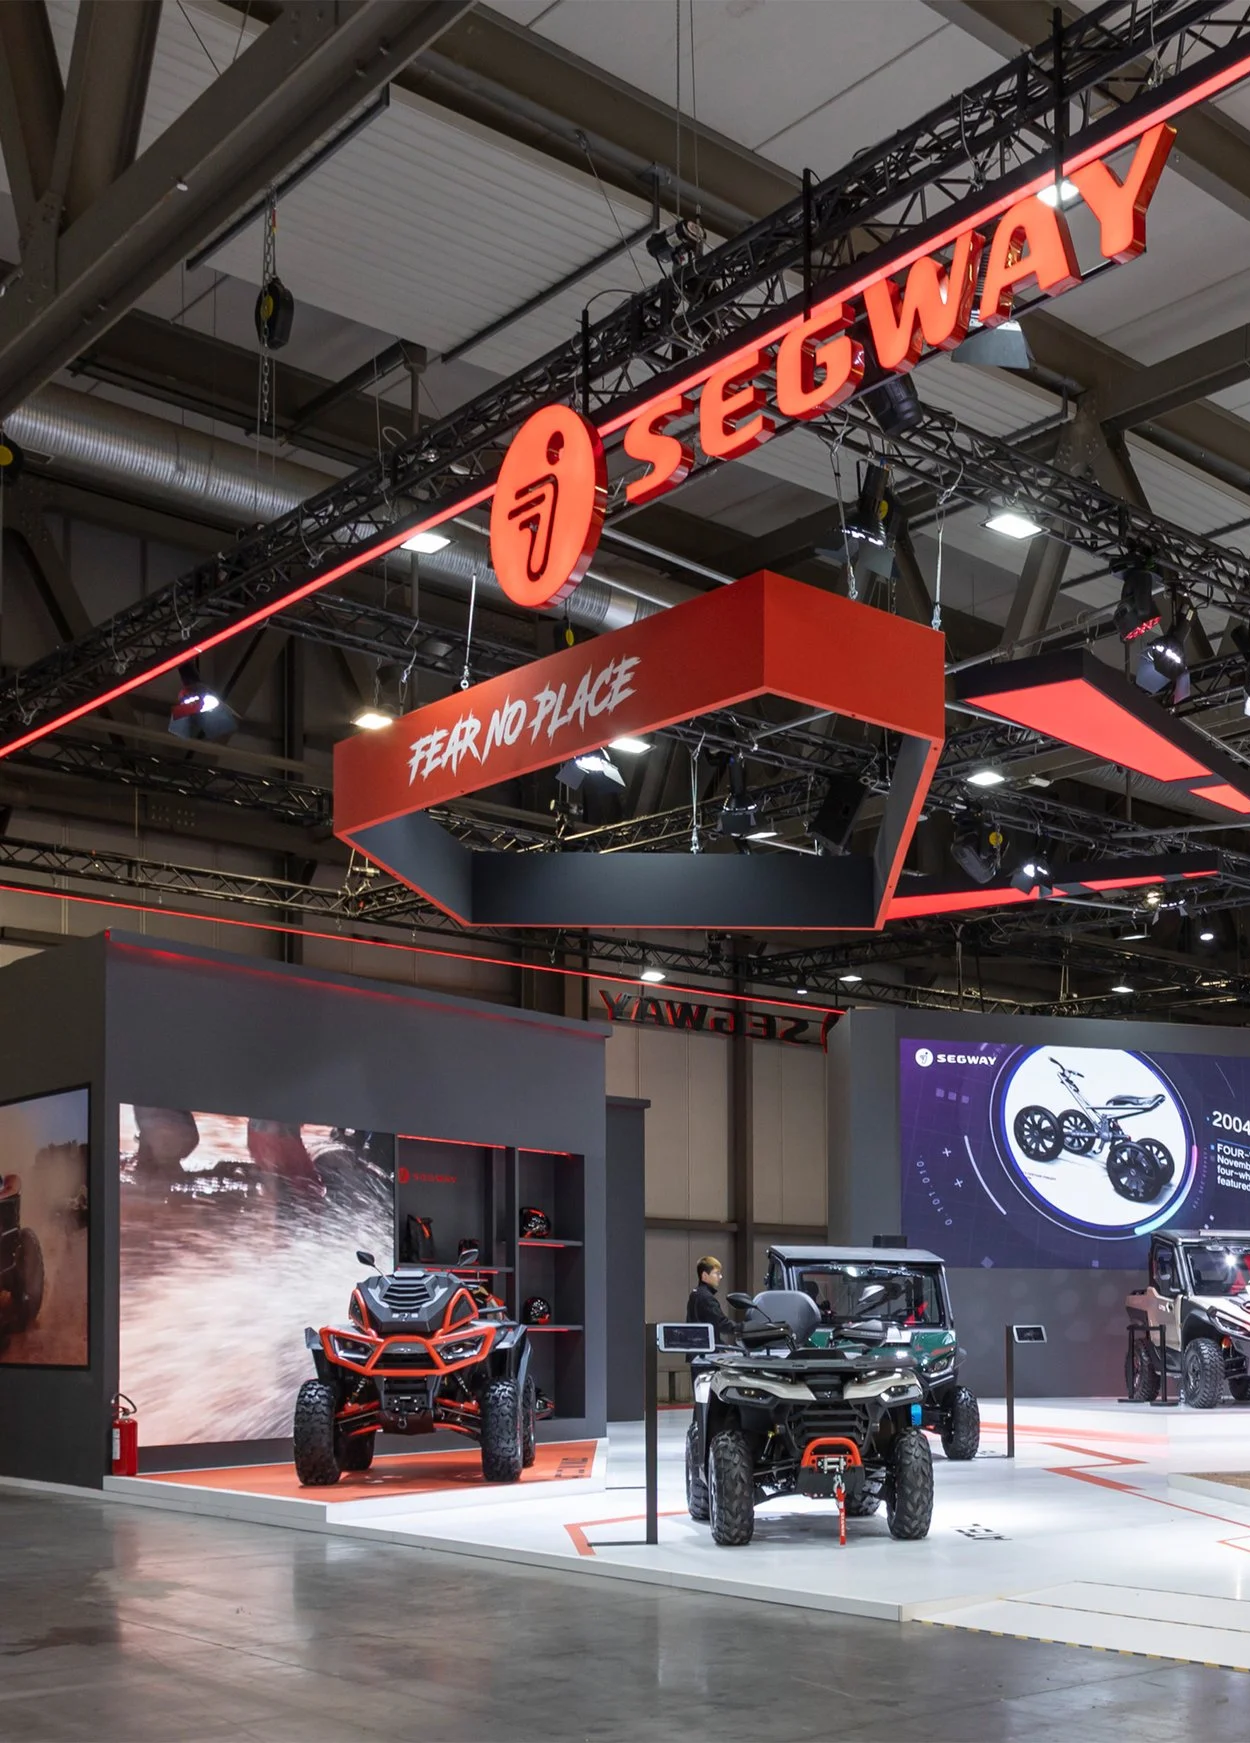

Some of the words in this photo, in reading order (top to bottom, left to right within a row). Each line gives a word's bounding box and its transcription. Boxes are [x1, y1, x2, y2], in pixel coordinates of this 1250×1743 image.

[623, 122, 1177, 506] SEGWAY
[406, 709, 482, 787] FEAR
[481, 694, 527, 766] NO
[528, 654, 642, 747] PLACE
[936, 1053, 997, 1066] SEGWAY
